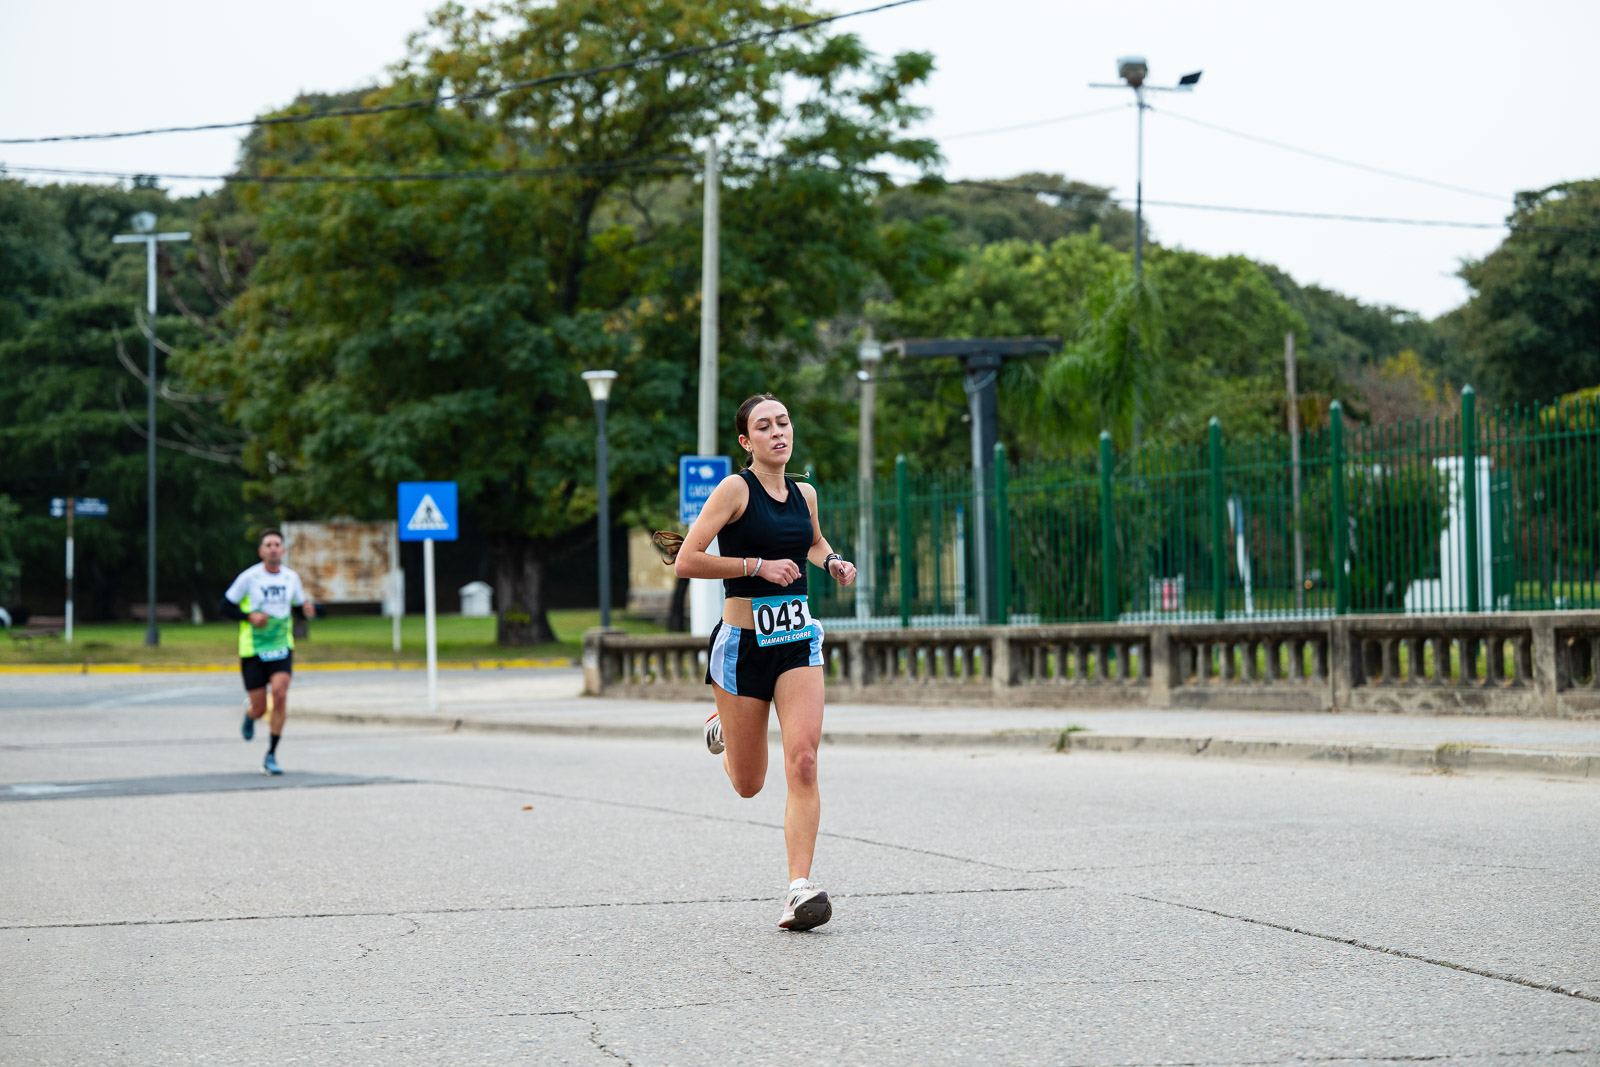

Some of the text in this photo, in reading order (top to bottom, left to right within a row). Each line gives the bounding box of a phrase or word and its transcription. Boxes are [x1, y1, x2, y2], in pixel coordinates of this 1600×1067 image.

[757, 599, 806, 636] 043
[761, 630, 812, 646] DIAMANTE CORRE
